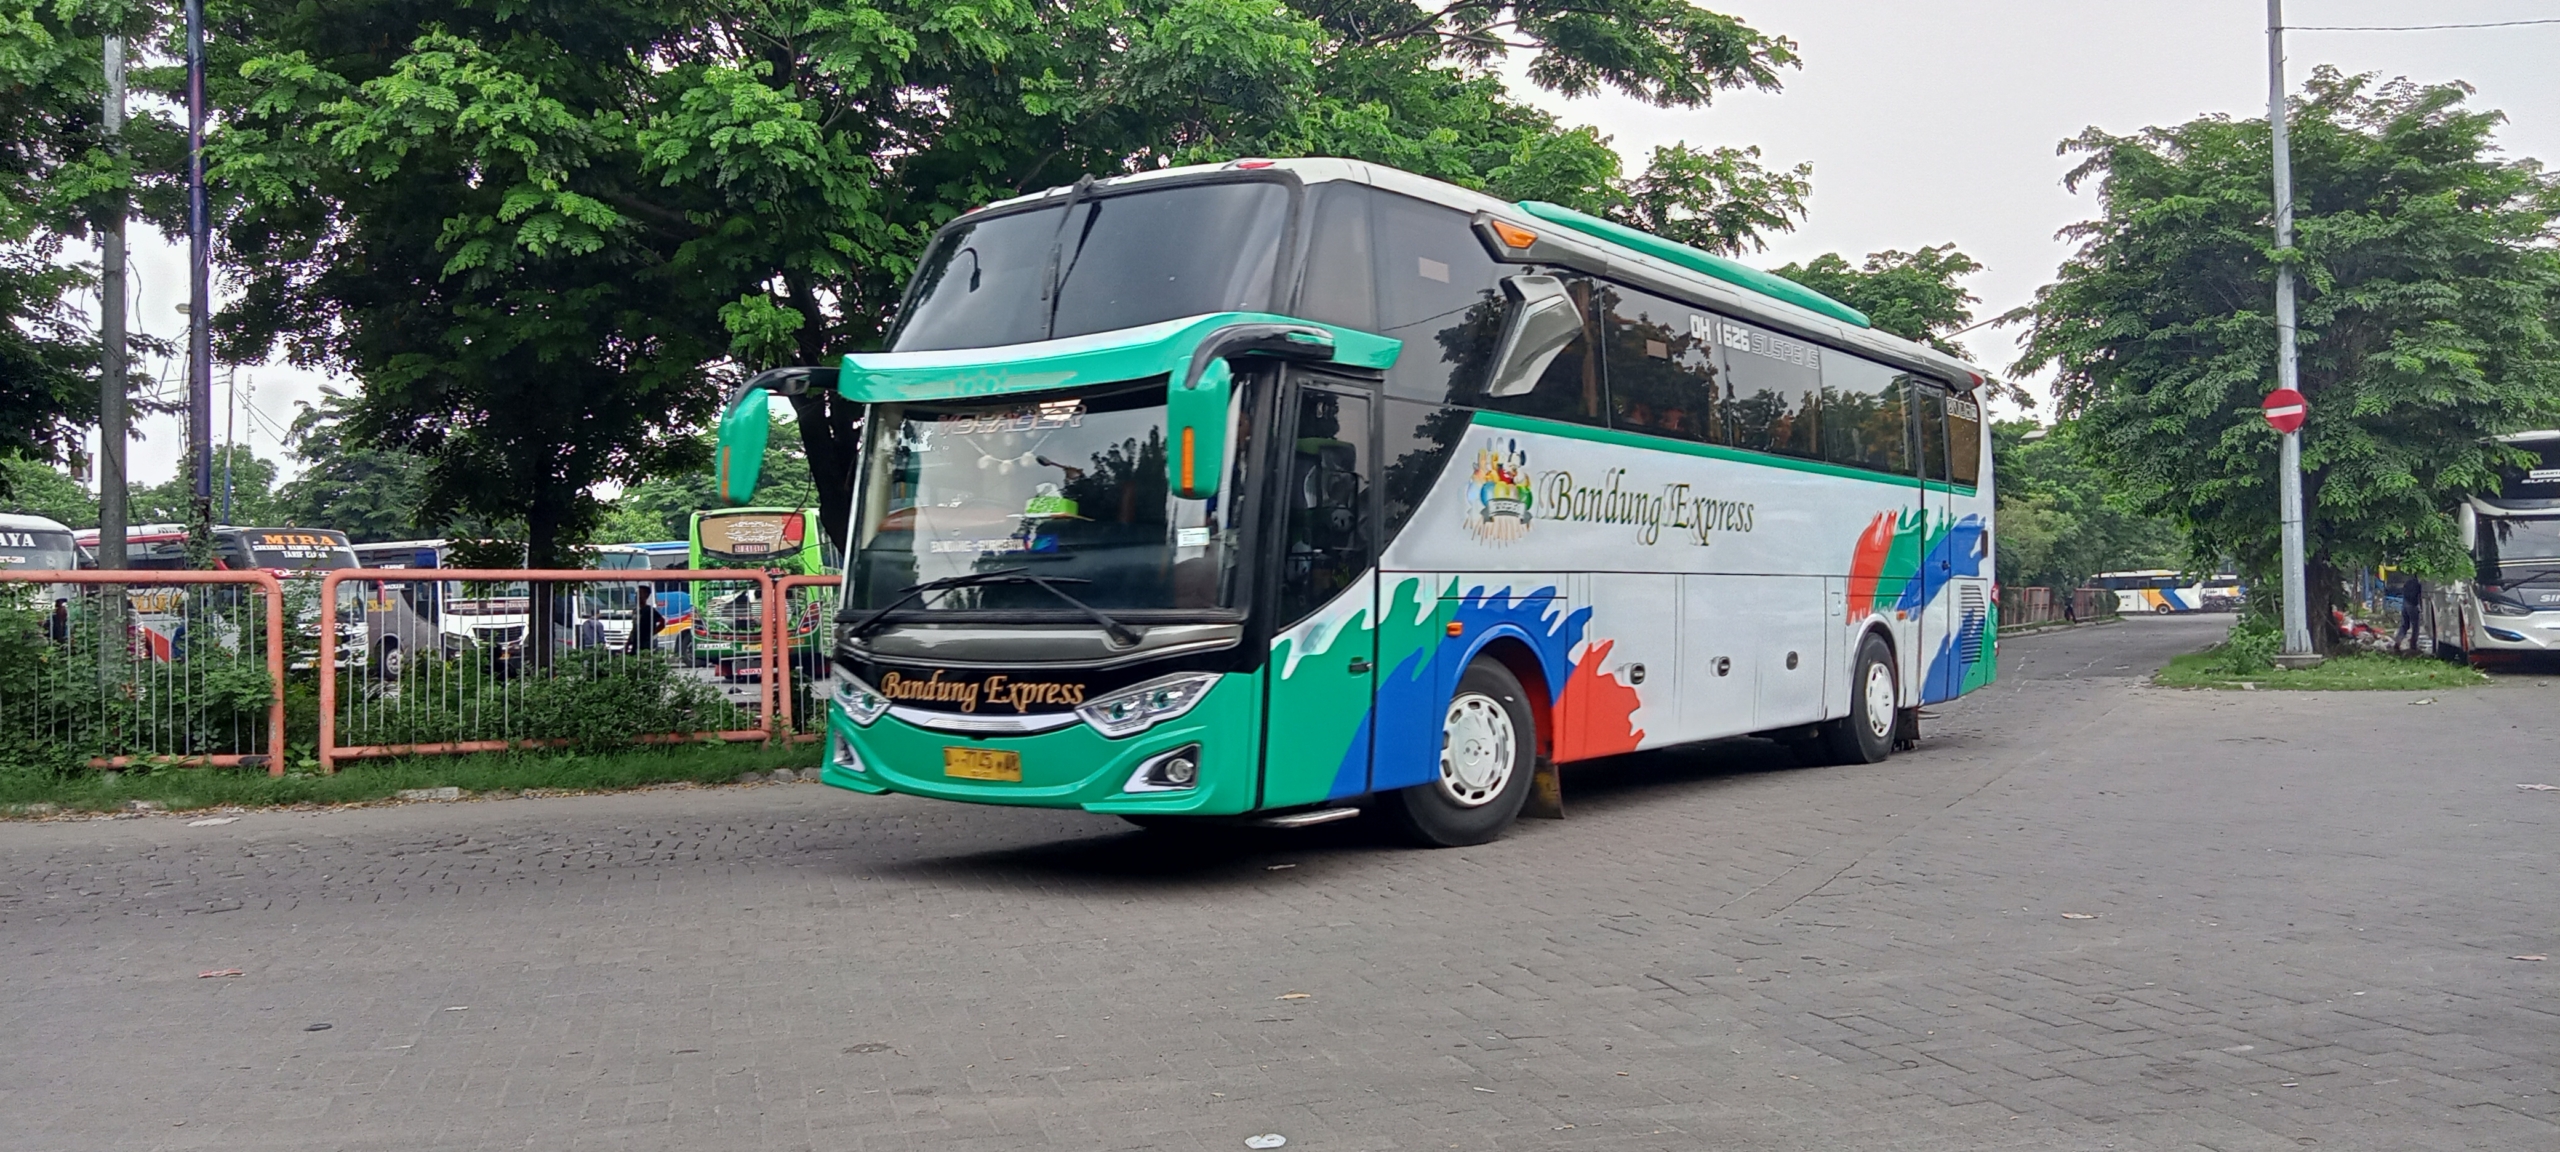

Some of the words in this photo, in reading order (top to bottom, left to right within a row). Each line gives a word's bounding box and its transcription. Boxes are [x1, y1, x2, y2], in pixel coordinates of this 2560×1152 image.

[1689, 314, 1711, 341] OH
[1715, 322, 1750, 352] 1626
[1548, 468, 1663, 546] Bandung
[1669, 483, 1755, 547] Express
[262, 534, 338, 546] MIRA
[880, 669, 980, 713] Bandung
[983, 675, 1086, 714] Express
